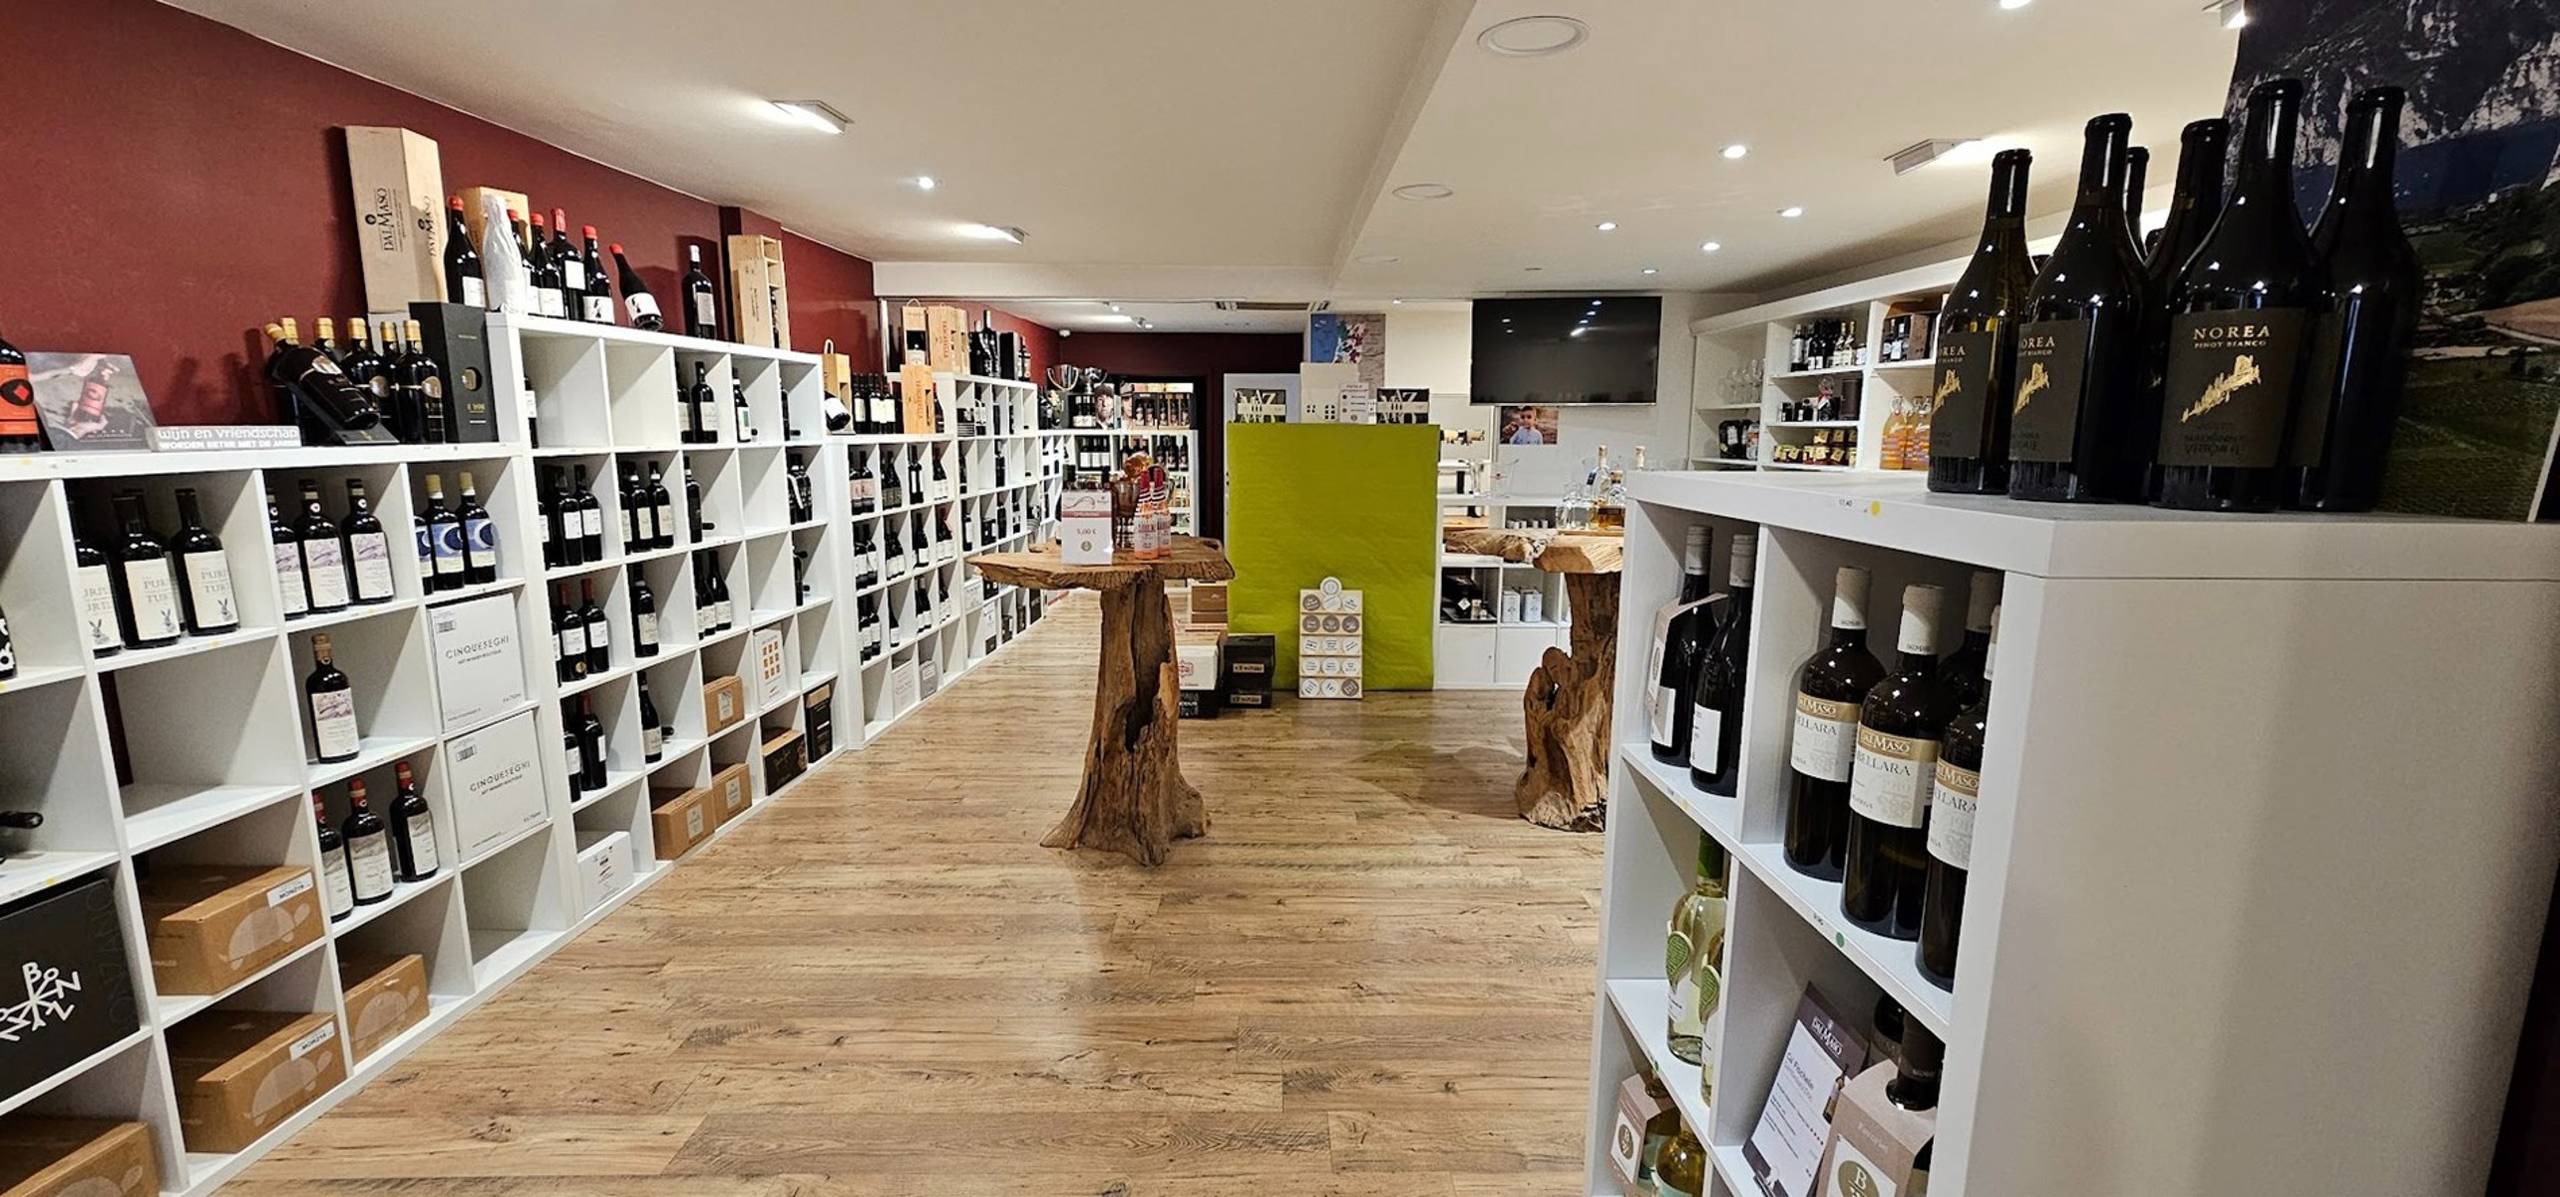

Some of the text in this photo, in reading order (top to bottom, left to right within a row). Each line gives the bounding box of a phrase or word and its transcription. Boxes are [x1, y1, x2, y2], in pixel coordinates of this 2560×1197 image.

[2194, 324, 2270, 341] NOREA
[2019, 335, 2056, 350] OREA
[2194, 340, 2266, 349] PINOT BIANCO
[159, 427, 299, 441] wijn en vriendschap
